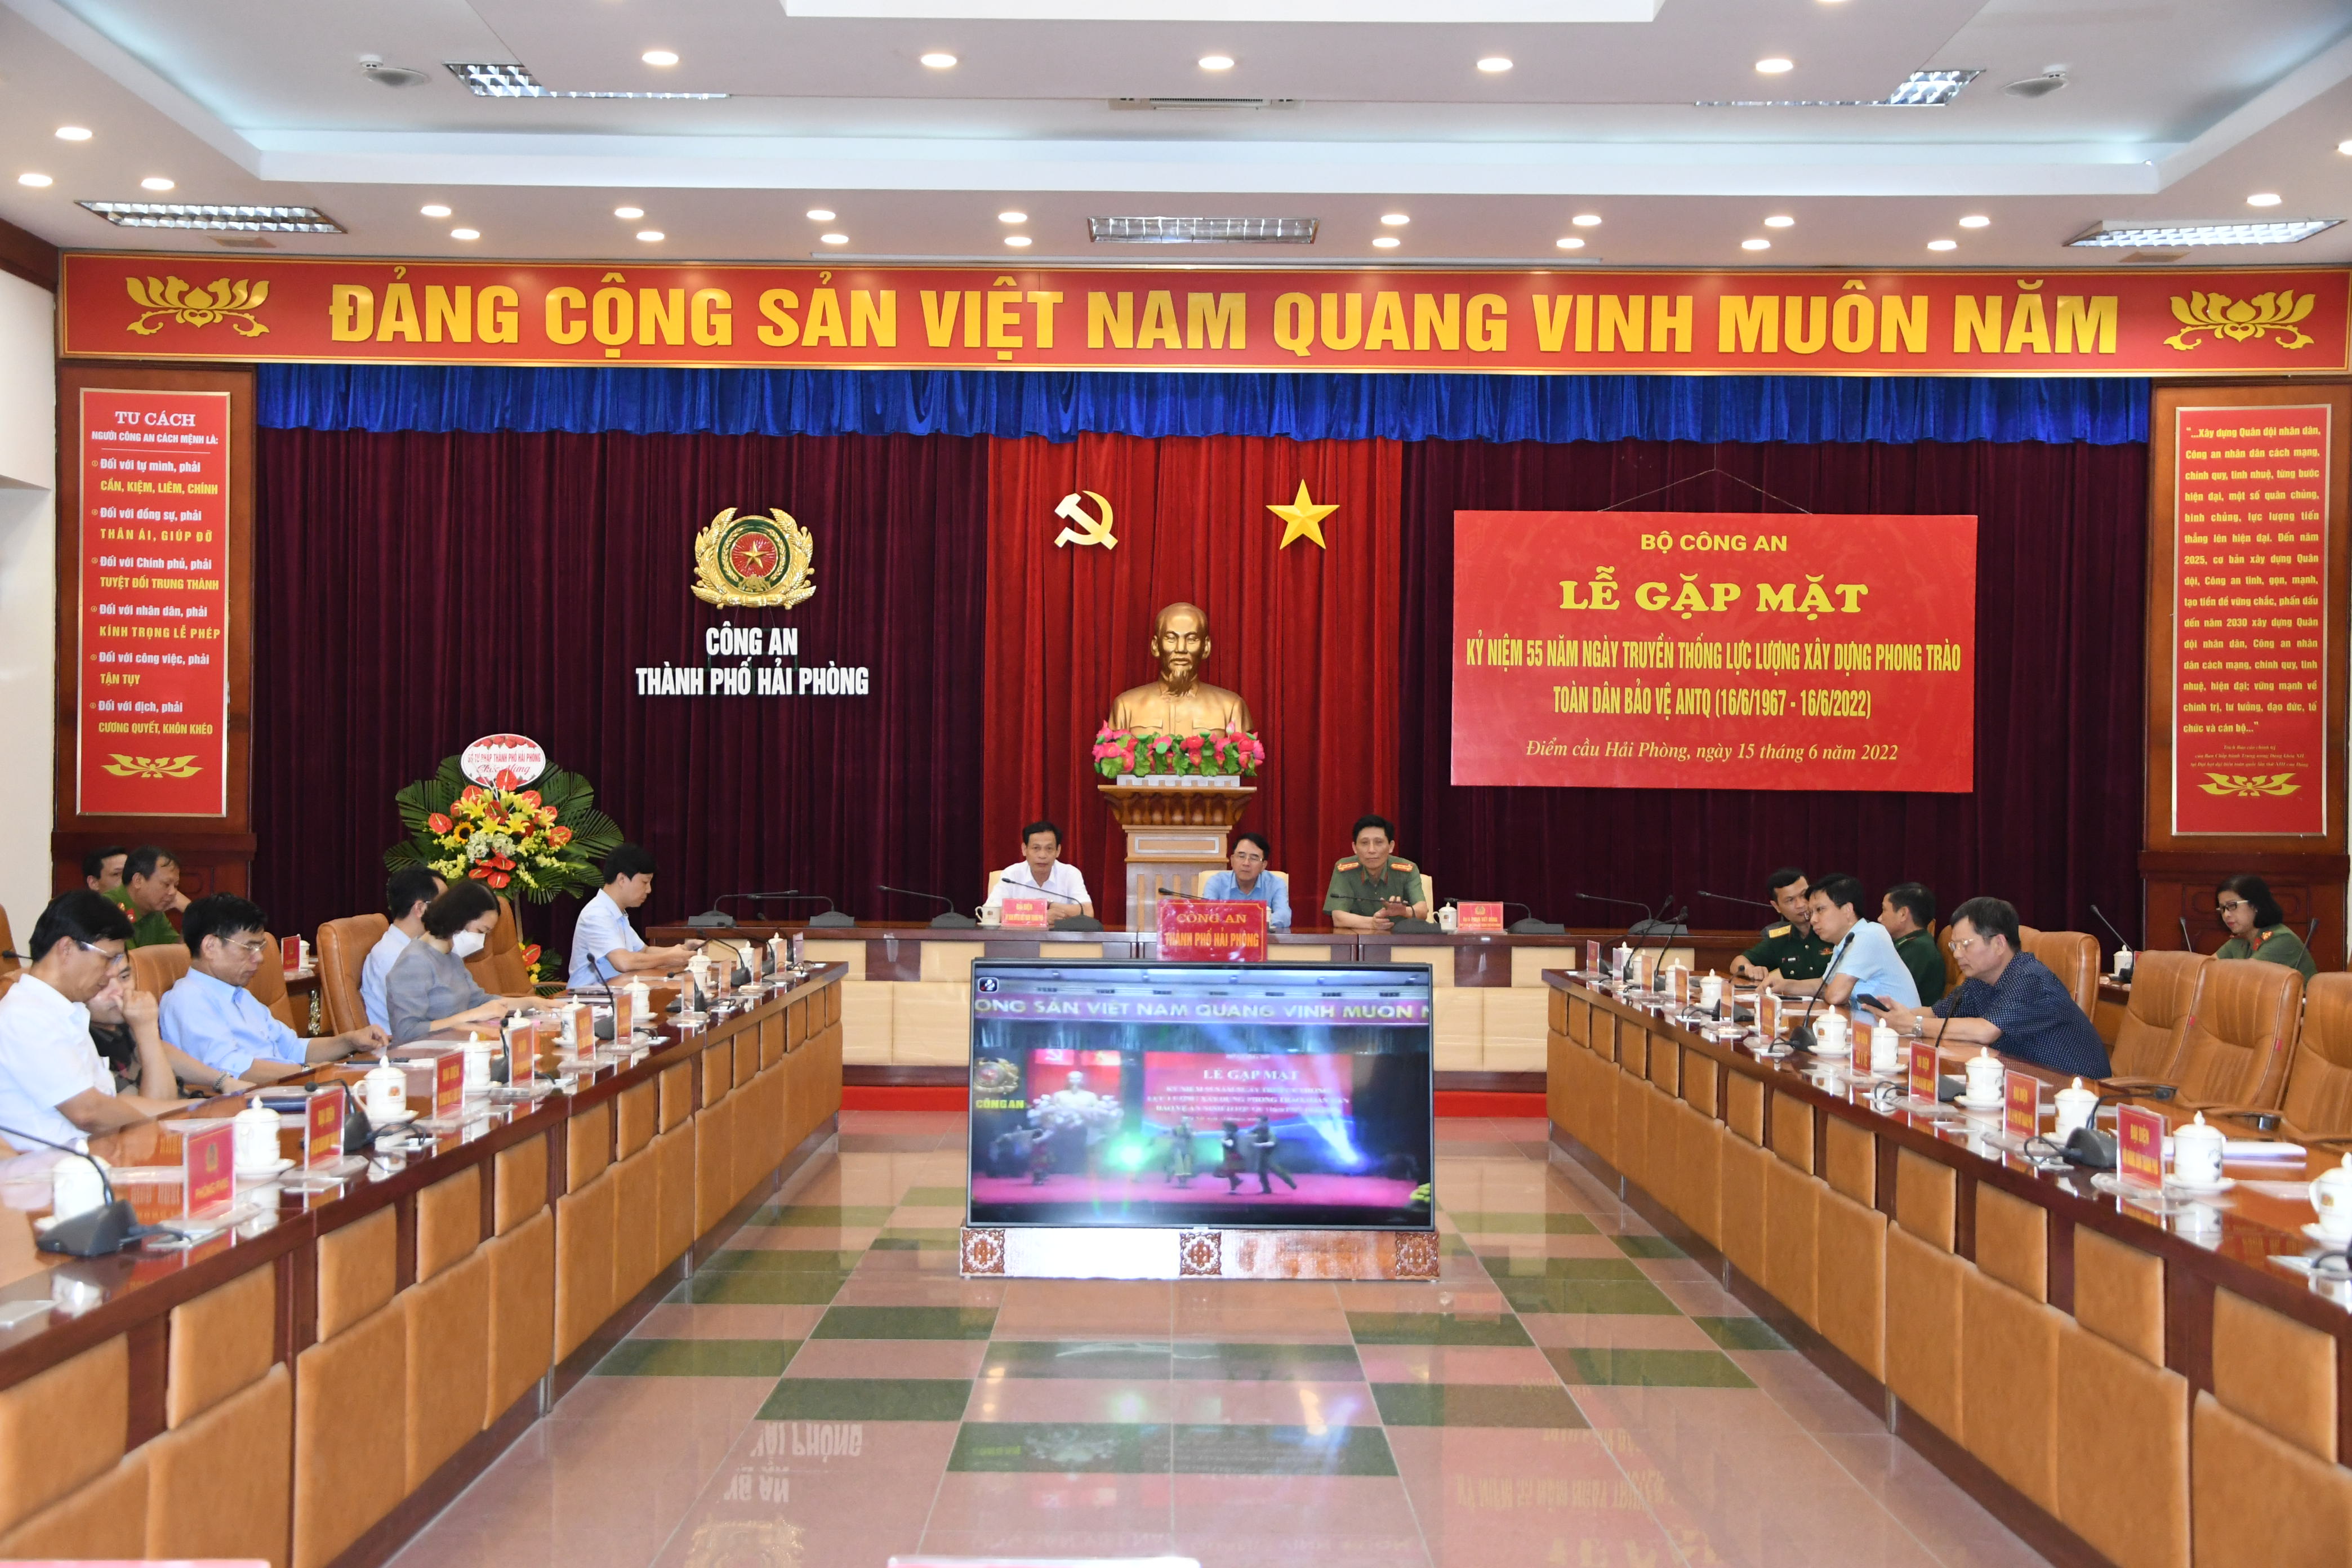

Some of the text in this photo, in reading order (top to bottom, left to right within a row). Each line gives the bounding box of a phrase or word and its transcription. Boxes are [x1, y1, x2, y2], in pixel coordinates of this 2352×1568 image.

[329, 264, 2117, 360] ĐẢNG CỘNG SẢN VIỆT NAM QUANG VINH MUÔN NĂM
[145, 410, 195, 426] CÁCH
[92, 430, 117, 440] NGƯỜI
[119, 431, 141, 442] CÔNG
[143, 434, 155, 442] AN
[157, 433, 179, 443] CÁCH
[2185, 449, 2207, 460] Công
[2225, 449, 2246, 458] nhân
[2249, 449, 2265, 458] dân
[2269, 448, 2290, 457] cách
[100, 457, 117, 469] Đối
[179, 461, 201, 473] phải
[127, 480, 155, 494] KIỆM,
[158, 481, 185, 495] LIÊM,
[188, 482, 218, 495] CHÍNH
[100, 506, 116, 518] Đối
[180, 509, 202, 522] phải
[100, 528, 133, 540] THÂN
[161, 529, 191, 541] GIÚP
[1641, 531, 1787, 554] BỘ CÔNG AN
[2250, 554, 2265, 564] xây
[2270, 554, 2291, 565] dựng
[2297, 554, 2319, 563] Quân
[100, 574, 219, 590] TUYỆT ĐỐI TRUNG THÀNH
[2204, 576, 2226, 586] Công
[1559, 566, 1868, 621] LỄ GẶP MẶT
[2226, 618, 2247, 627] 2030
[2252, 618, 2267, 627] xây
[2271, 618, 2292, 628] dựng
[2297, 617, 2318, 627] Quân
[100, 624, 220, 639] KÍNH TRỌNG LỄ PHÉP
[706, 621, 798, 655] CÔNG AN
[1467, 629, 1961, 676] KỶ NIỆM 55 NĂM NGÀY TRUYỀN THỐNG LỰC LƯỢNG XÂY DỰNG PHONG TRÀO
[100, 672, 140, 687] TẬN TỤY
[636, 657, 868, 695] THÀNH PHỐ HẢI PHÒNG
[1553, 682, 1588, 713] TOÀN
[1592, 682, 1620, 714] DÂN
[1624, 678, 1651, 714] BẢO
[1655, 688, 1671, 720] VỆ
[1676, 688, 1710, 718] ANTQ
[1716, 688, 1787, 718] (16/6/1967
[1801, 689, 1870, 719] 16/6/2022)
[99, 722, 129, 733] CƯƠNG
[163, 722, 188, 734] KHÔN
[189, 723, 213, 734] KHÉO
[1526, 737, 1898, 763] Điểm cầu Hải Phòng, ngày 15 tháng 6 năm 2022
[1177, 911, 1247, 923] CÔNG AN
[1165, 926, 1259, 946] THÀNH PHỐ HẢI PHÒNG
[1137, 1003, 1188, 1016] NAM
[1196, 1004, 1275, 1017] QUANG
[1284, 1005, 1334, 1018] VINH
